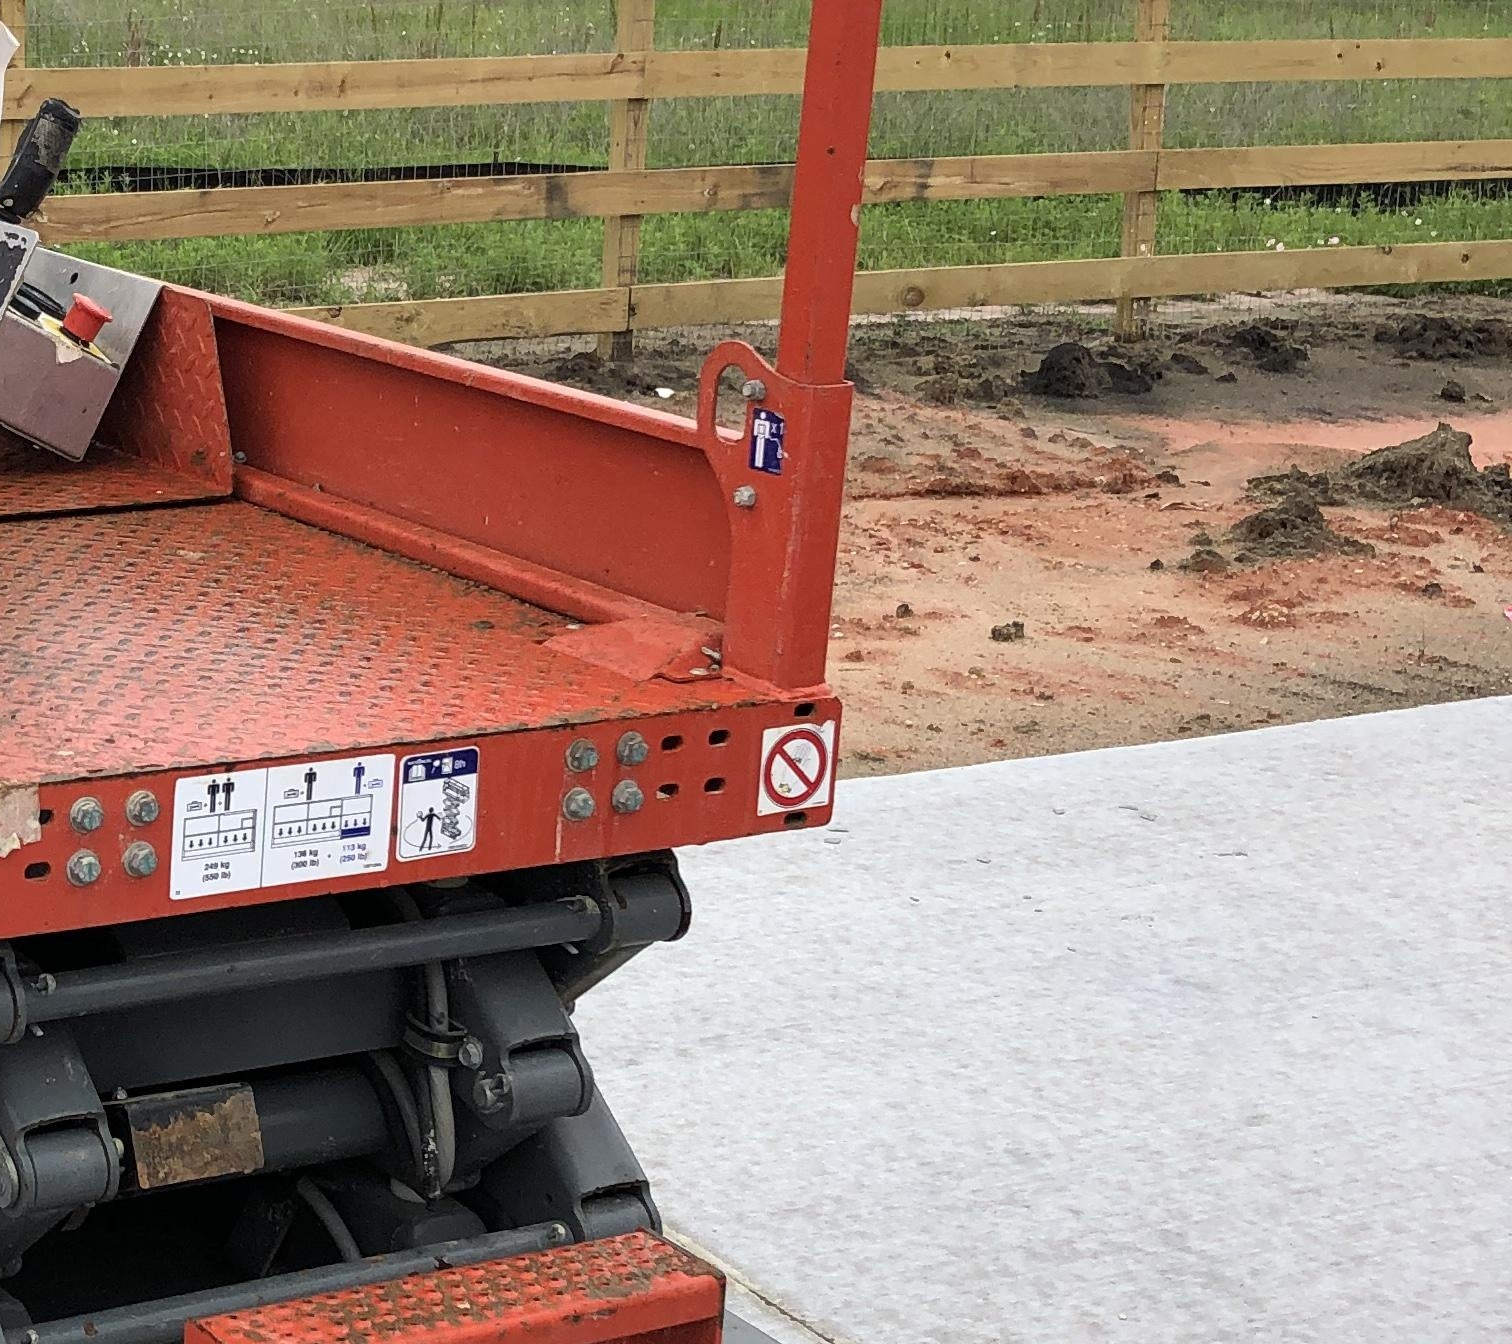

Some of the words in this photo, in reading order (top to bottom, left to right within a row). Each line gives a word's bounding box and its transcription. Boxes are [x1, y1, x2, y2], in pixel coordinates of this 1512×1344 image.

[357, 843, 366, 851] kg
[309, 849, 318, 857] kg
[357, 853, 367, 861] lb)
[221, 861, 229, 870] kg
[309, 859, 319, 867] lb)
[221, 871, 231, 880] lb)
